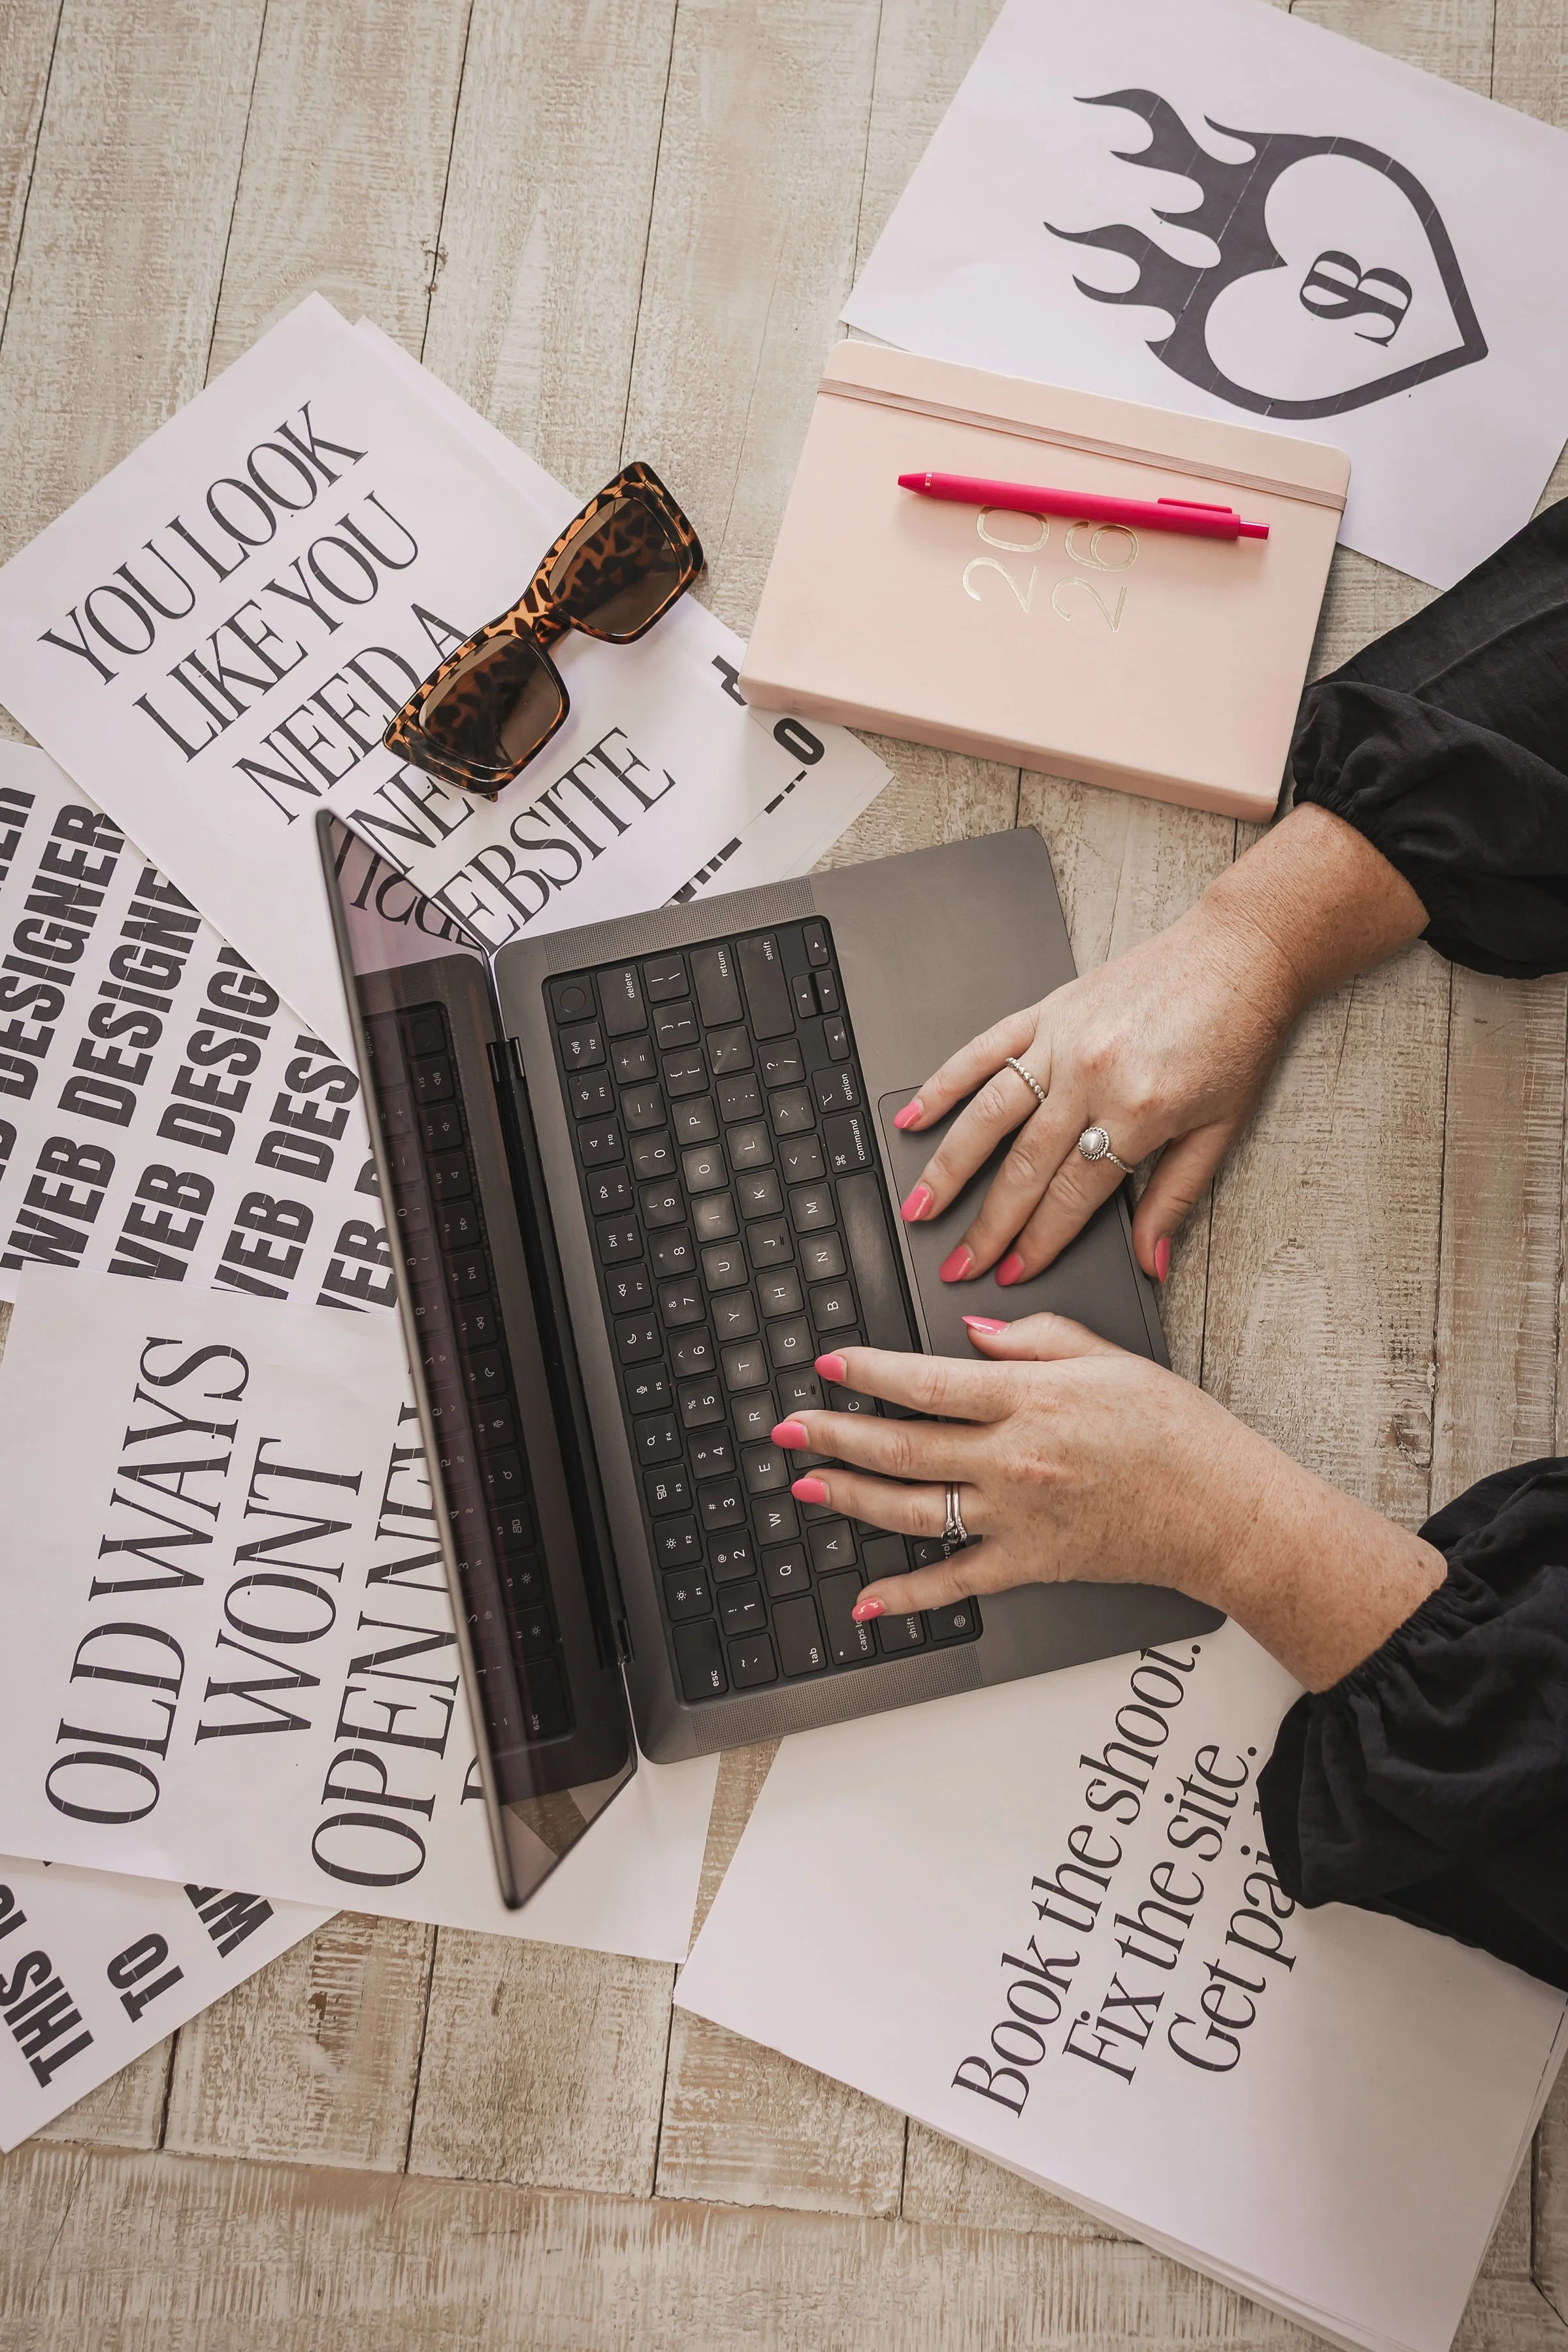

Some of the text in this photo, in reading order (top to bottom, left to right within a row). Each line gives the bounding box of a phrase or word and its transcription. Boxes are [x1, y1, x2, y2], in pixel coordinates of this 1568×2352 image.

[37, 400, 368, 685] YOU LOOK
[962, 506, 1050, 613] 20
[1051, 521, 1139, 632] 26
[132, 491, 418, 762] LIKE YOU
[233, 602, 472, 825] NEED A
[347, 762, 477, 875] NE
[431, 727, 676, 958] EBSITE
[763, 941, 774, 960] shift
[717, 951, 728, 977] return
[625, 973, 635, 998] delete
[156, 939, 280, 1155] DESIG
[0, 857, 202, 1271] WEB DESIGNE
[841, 1073, 853, 1100] option
[689, 1117, 701, 1125] P
[744, 1141, 755, 1150] L
[849, 1119, 866, 1160] command
[753, 1189, 766, 1199] K
[664, 1198, 676, 1207] 9
[806, 1201, 818, 1214] M
[627, 1232, 634, 1241] F8
[208, 1192, 314, 1300] EB
[674, 1247, 685, 1256] 8
[816, 1251, 828, 1262] N
[316, 1218, 398, 1313] EB
[718, 1262, 730, 1272] U
[774, 1287, 786, 1298] H
[827, 1301, 839, 1311] B
[728, 1313, 740, 1322] Y
[646, 1331, 653, 1340] F6
[784, 1337, 796, 1347] G
[693, 1346, 705, 1355] 6
[738, 1363, 750, 1371] T
[655, 1382, 662, 1390] F5
[702, 1396, 715, 1405] 5
[848, 1401, 860, 1411] C
[749, 1411, 760, 1422] R
[666, 1432, 672, 1441] F4
[713, 1446, 724, 1455] 4
[759, 1463, 771, 1473] E
[676, 1483, 682, 1492] F3
[723, 1498, 735, 1507] 3
[768, 1513, 781, 1527] W
[685, 1535, 693, 1544] F2
[826, 1540, 838, 1550] A
[733, 1549, 745, 1559] 2
[779, 1565, 792, 1576] Q
[44, 1336, 250, 1825] OLD WAYS
[194, 1437, 363, 1746] WONT
[696, 1587, 702, 1595] F1
[312, 1360, 460, 1887] OPEN NE
[906, 1617, 917, 1639] shift
[858, 1628, 868, 1650] caps
[809, 1648, 819, 1663] tab
[711, 1670, 719, 1687] esc
[951, 1644, 1201, 2119] Book the shoot.
[1062, 1744, 1258, 2085] Fix the site.
[107, 1933, 185, 2023] TO
[0, 1950, 95, 2088] THIS
[1167, 1957, 1267, 2072] Get
